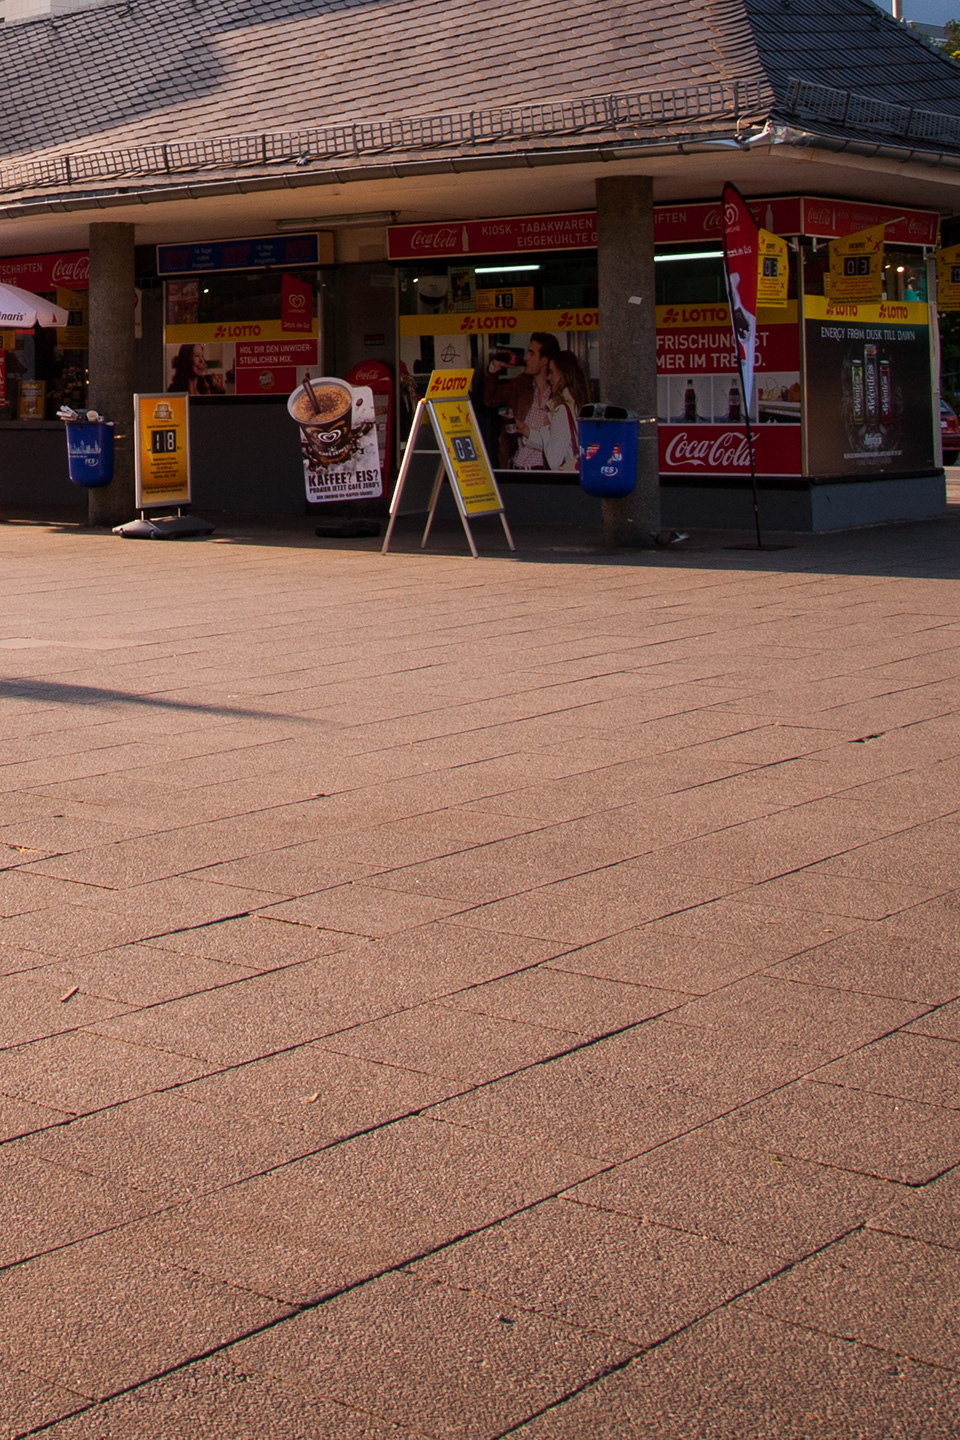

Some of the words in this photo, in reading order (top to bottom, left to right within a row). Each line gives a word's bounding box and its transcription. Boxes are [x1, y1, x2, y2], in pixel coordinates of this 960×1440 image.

[482, 222, 512, 236] KIOSK
[520, 218, 593, 235] TABAKWAREN
[411, 227, 459, 250] Coca-Cola
[517, 231, 588, 247] EISGEKÜHLTE
[847, 260, 867, 274] 03
[497, 294, 512, 308] 18
[682, 308, 728, 322] LOTTO
[836, 305, 858, 317] LOTTO
[888, 306, 909, 319] LOTTO
[477, 316, 517, 329] LOTTO
[228, 325, 261, 338] LOTTO
[821, 327, 845, 342] ENERGY
[847, 328, 865, 339] FROM
[866, 329, 882, 340] DUSK
[884, 329, 896, 340] TILL
[897, 330, 916, 341] DAWN
[255, 345, 265, 353] DIR
[266, 345, 278, 353] DEN
[280, 344, 312, 352] UNWIDER-
[240, 356, 278, 365] STEHLICHEN
[690, 353, 707, 368] IM
[710, 352, 767, 368] TRED.
[355, 369, 380, 380] Coca-Cola
[441, 376, 468, 391] LOTTO
[156, 431, 175, 451] 18
[453, 437, 475, 459] 03
[665, 431, 760, 467] Coca-Cola
[601, 466, 615, 474] FES
[308, 471, 352, 487] KAFFEE?
[356, 469, 379, 483] EIS?
[333, 484, 347, 492] JETZT
